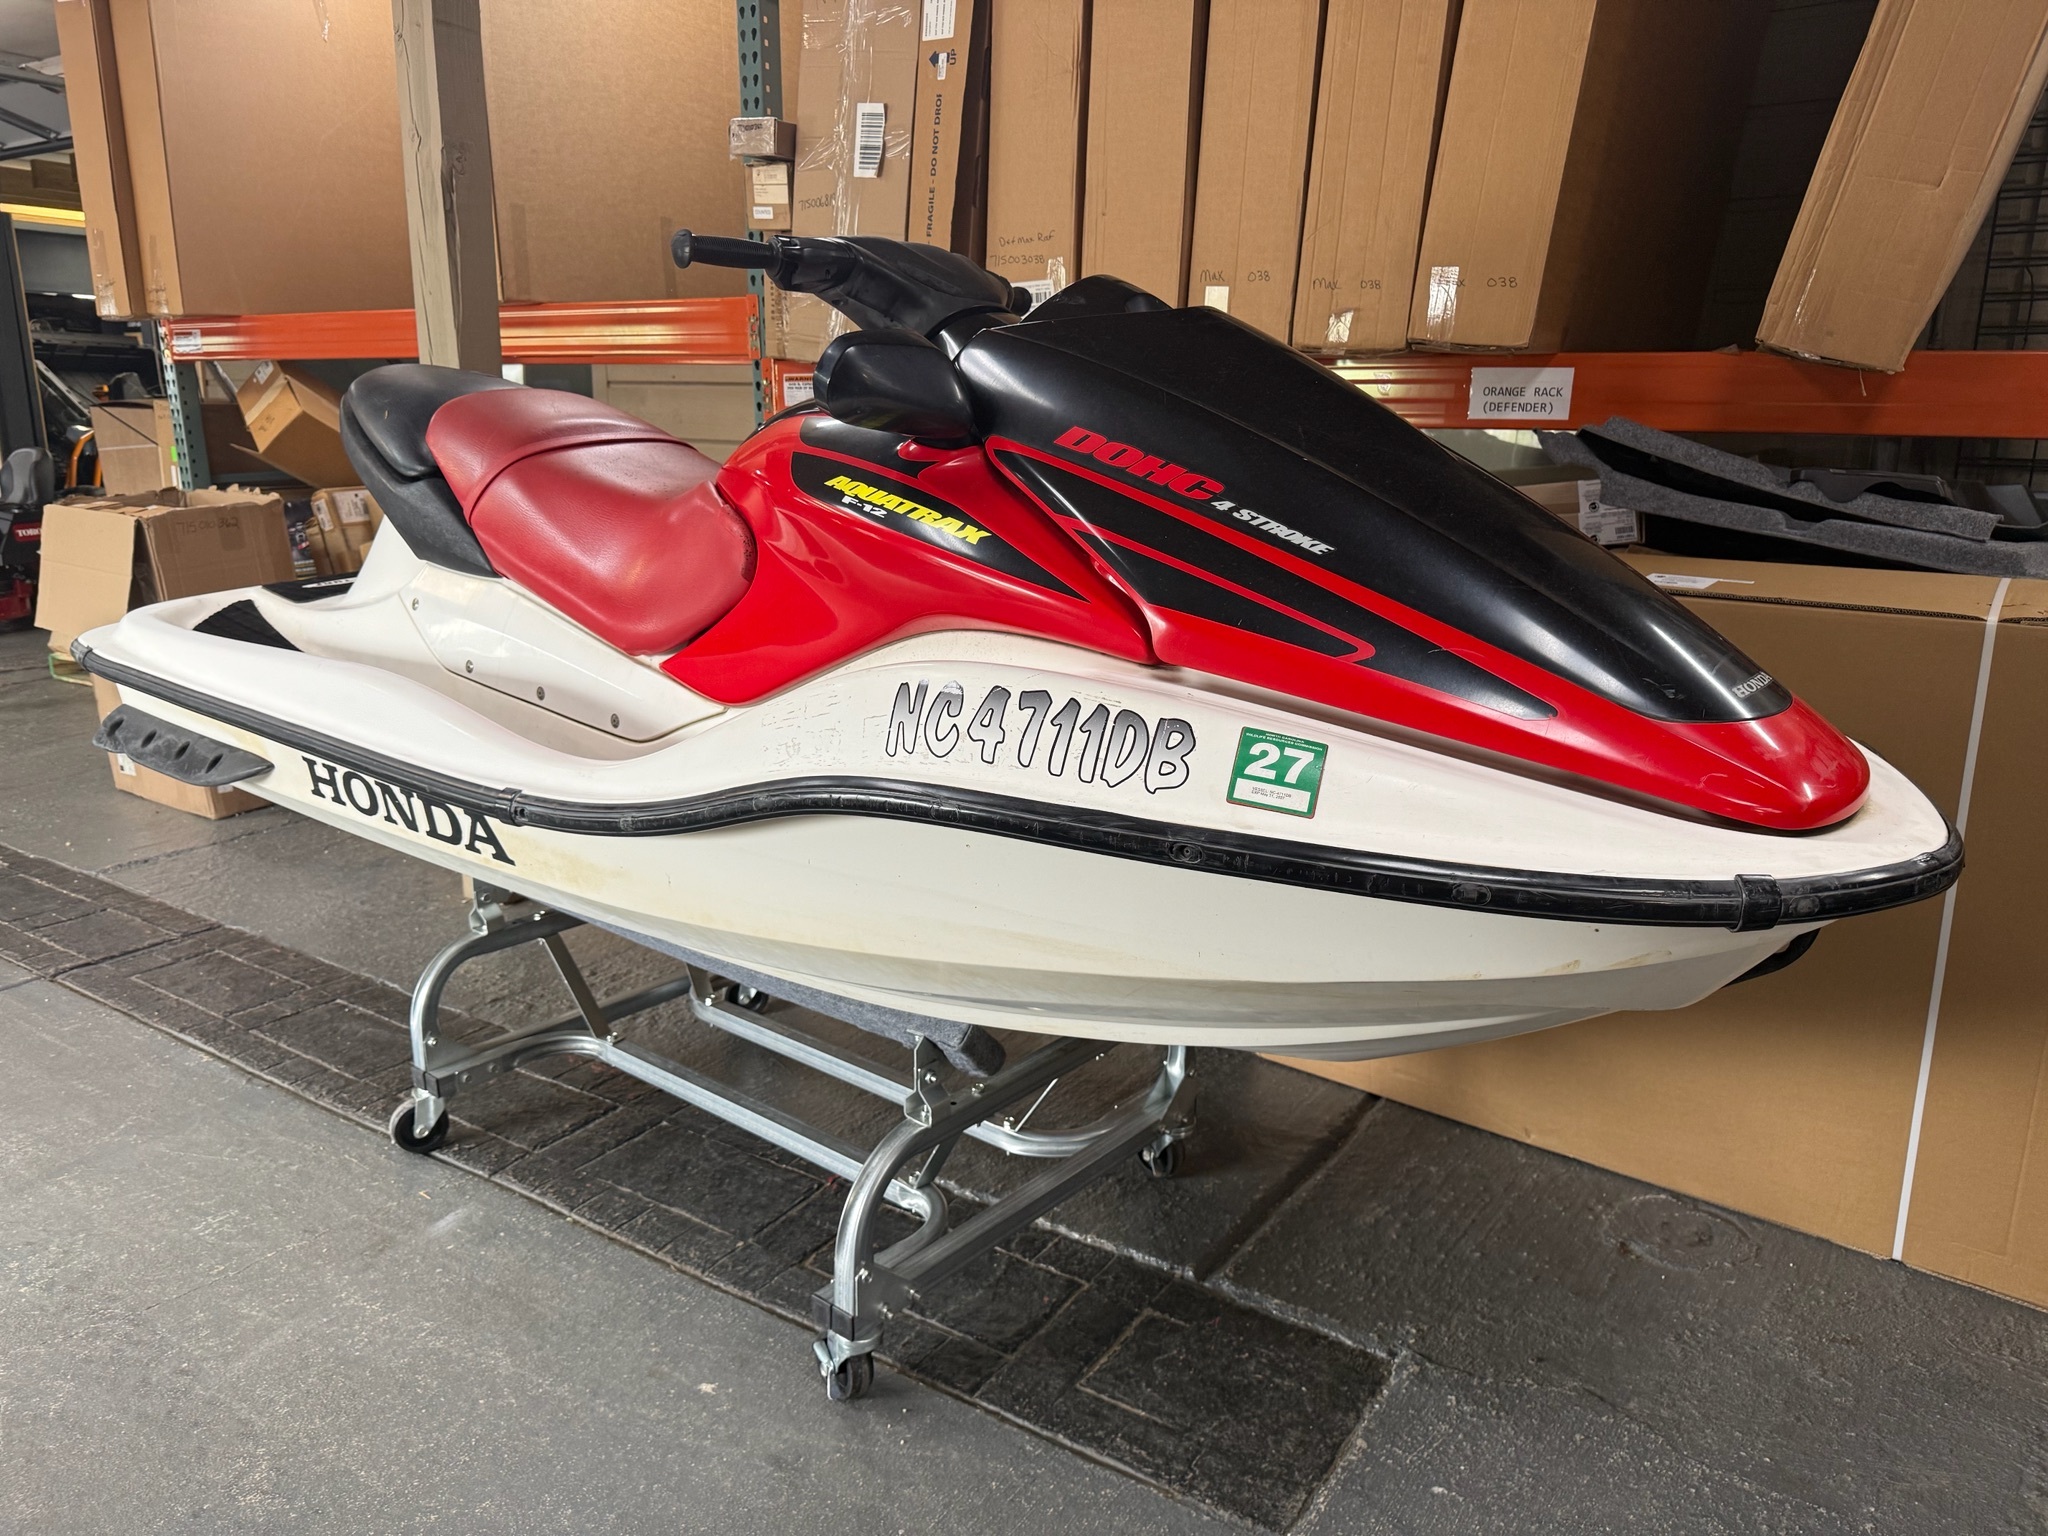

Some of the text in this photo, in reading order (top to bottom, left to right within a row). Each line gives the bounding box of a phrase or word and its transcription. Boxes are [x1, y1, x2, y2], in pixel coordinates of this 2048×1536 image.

[949, 48, 957, 66] UP
[932, 128, 941, 155] NOT
[930, 157, 938, 177] DO
[926, 187, 935, 237] FRAGILE
[989, 254, 1046, 267] 715003038
[1199, 268, 1271, 284] Max 038
[1312, 277, 1382, 291] Max 038
[1486, 276, 1519, 289] 038
[1482, 386, 1564, 398] ORANGE RACK
[1482, 401, 1554, 415] (DEFENDER)
[1053, 426, 1335, 555] DOHC 4 STROKE
[824, 475, 992, 545] AQUATRAX
[840, 495, 888, 518] F-12
[1731, 670, 1773, 698] HONDA
[1243, 742, 1315, 784] 27
[301, 755, 517, 867] HONDA
